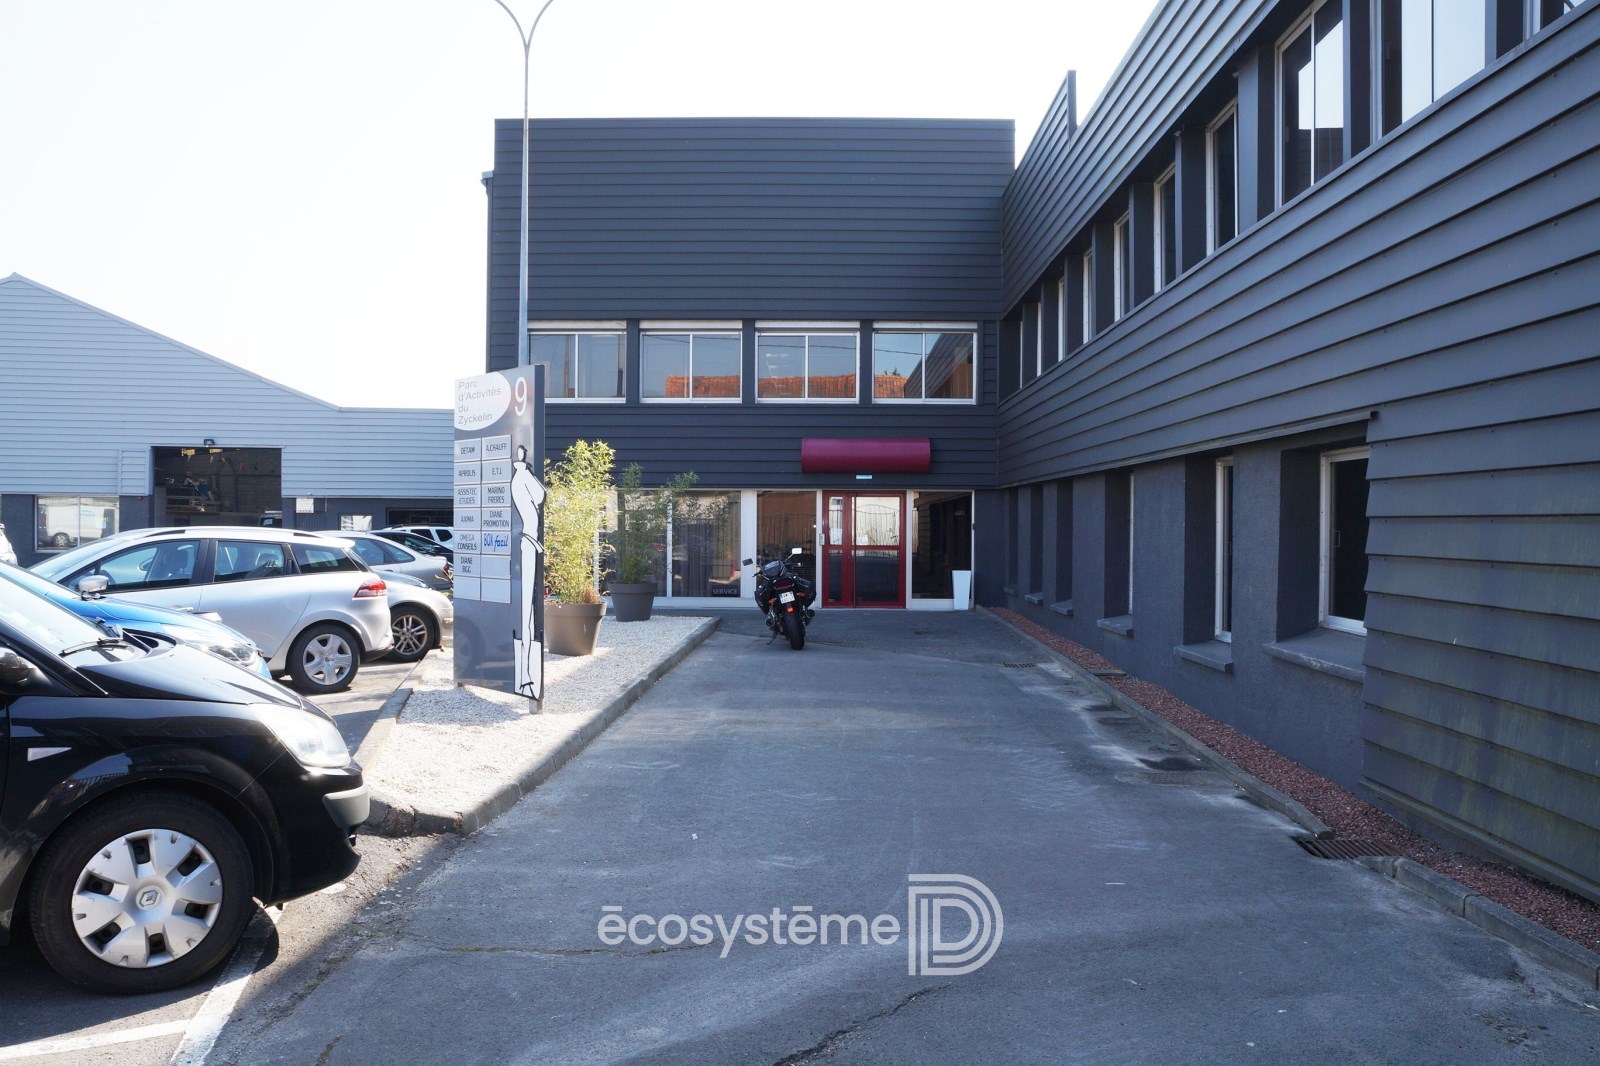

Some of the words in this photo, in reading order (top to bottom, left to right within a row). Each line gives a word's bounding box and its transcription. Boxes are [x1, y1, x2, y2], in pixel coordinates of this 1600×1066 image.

[458, 380, 478, 389] Parc
[458, 387, 502, 402] d'Activités
[514, 376, 528, 417] 9
[458, 404, 469, 413] du
[458, 412, 493, 426] Zyckelin
[457, 487, 477, 496] ASSISTEC
[487, 486, 506, 495] MARINO
[458, 497, 476, 505] ETUDES
[487, 495, 505, 504] FRERES
[489, 510, 503, 519] DIANE
[482, 519, 510, 528] PROMOTION
[459, 533, 475, 542] OMEGA
[457, 542, 478, 551] CONSEILS
[460, 556, 473, 565] DIANE
